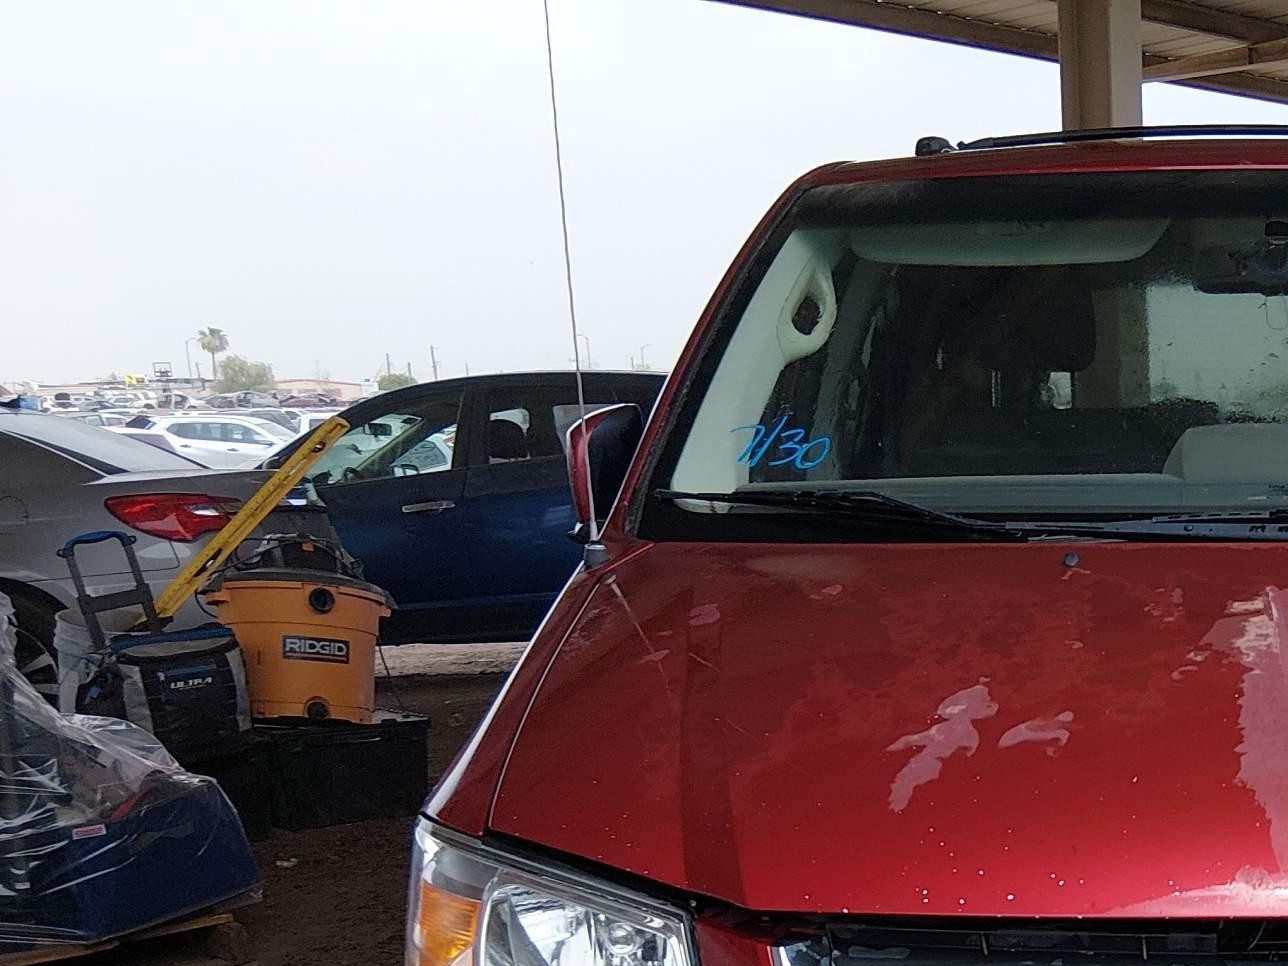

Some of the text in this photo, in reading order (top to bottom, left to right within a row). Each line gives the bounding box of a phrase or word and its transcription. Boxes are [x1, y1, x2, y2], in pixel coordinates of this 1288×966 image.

[729, 415, 832, 470] 7/30
[285, 638, 347, 655] RIDGID
[170, 677, 213, 689] ULTRA
